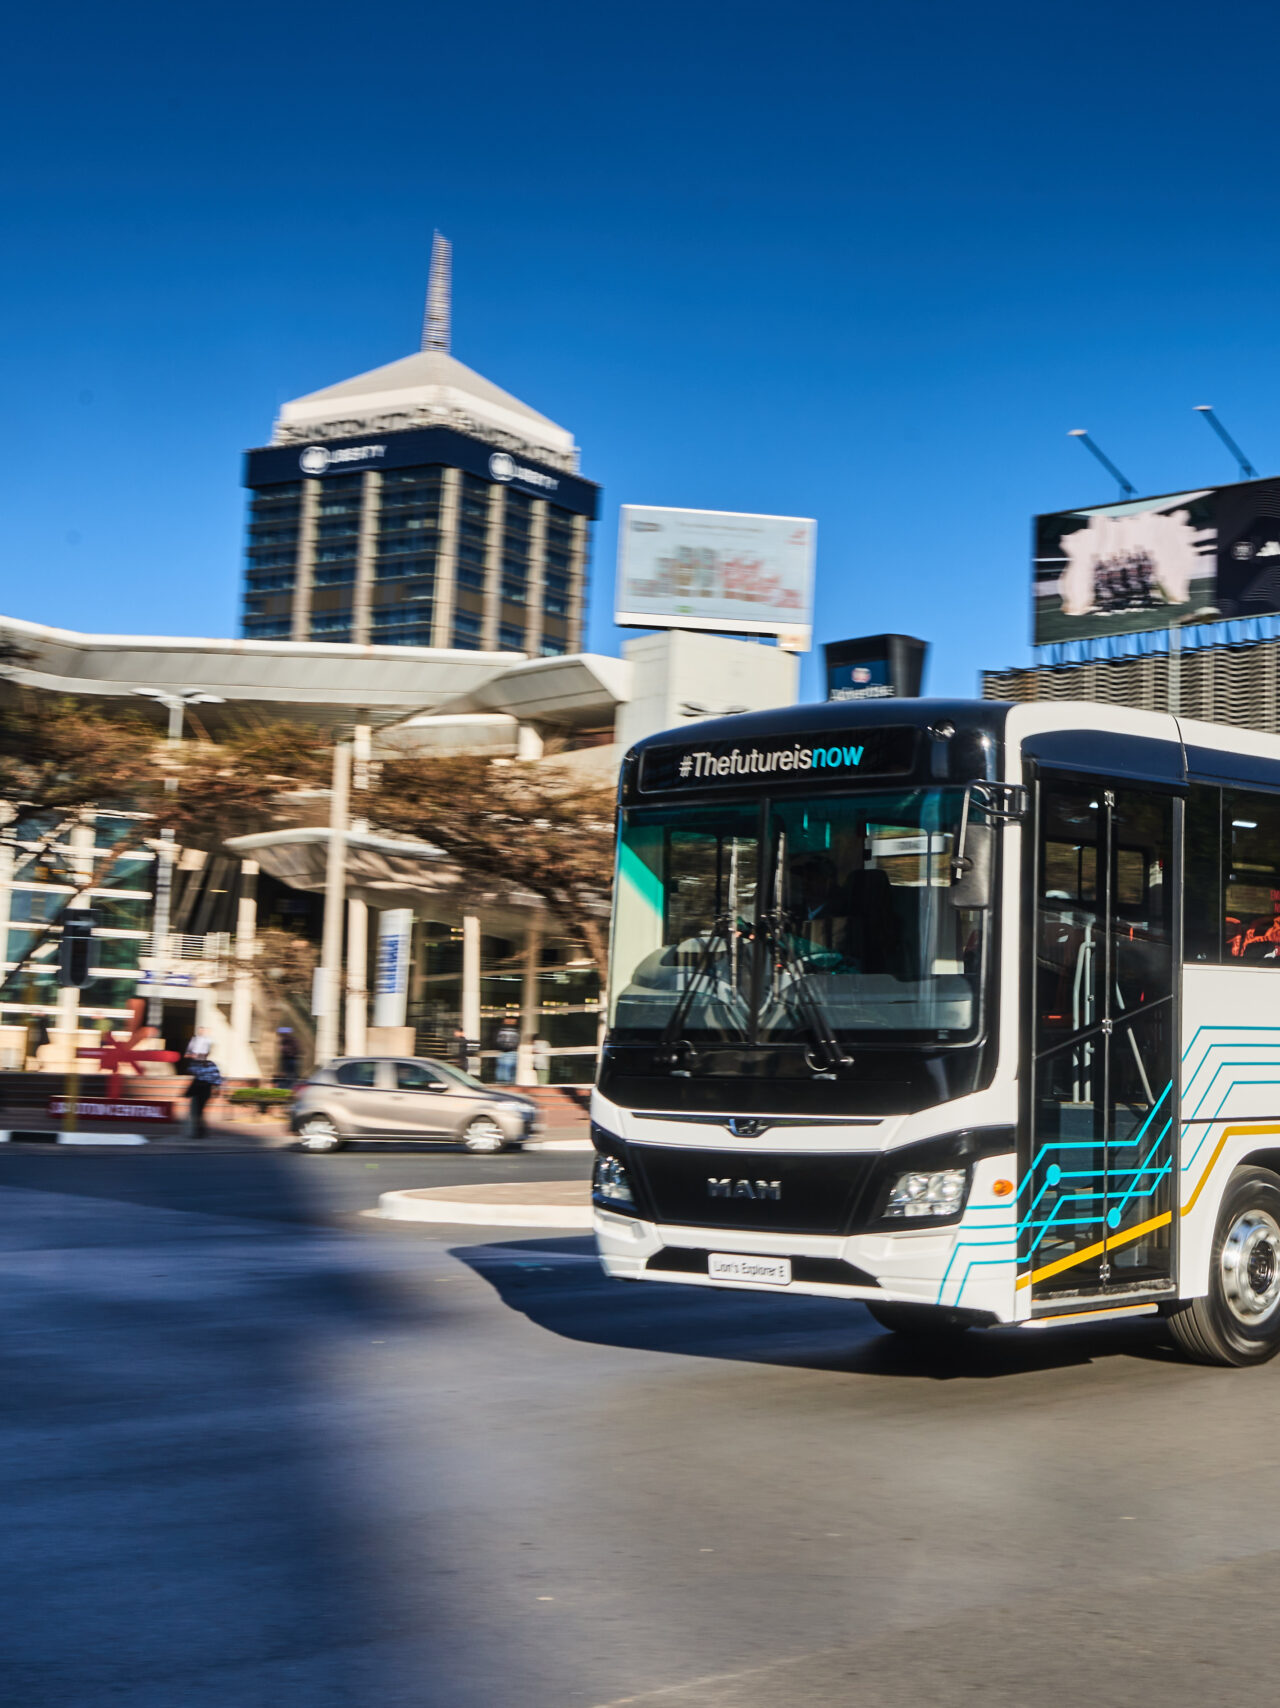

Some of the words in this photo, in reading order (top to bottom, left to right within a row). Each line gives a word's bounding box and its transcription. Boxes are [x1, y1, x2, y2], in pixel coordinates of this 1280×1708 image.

[678, 744, 865, 777] #Thefutureisnow
[707, 1177, 782, 1200] MAN
[742, 1261, 777, 1277] Explorer
